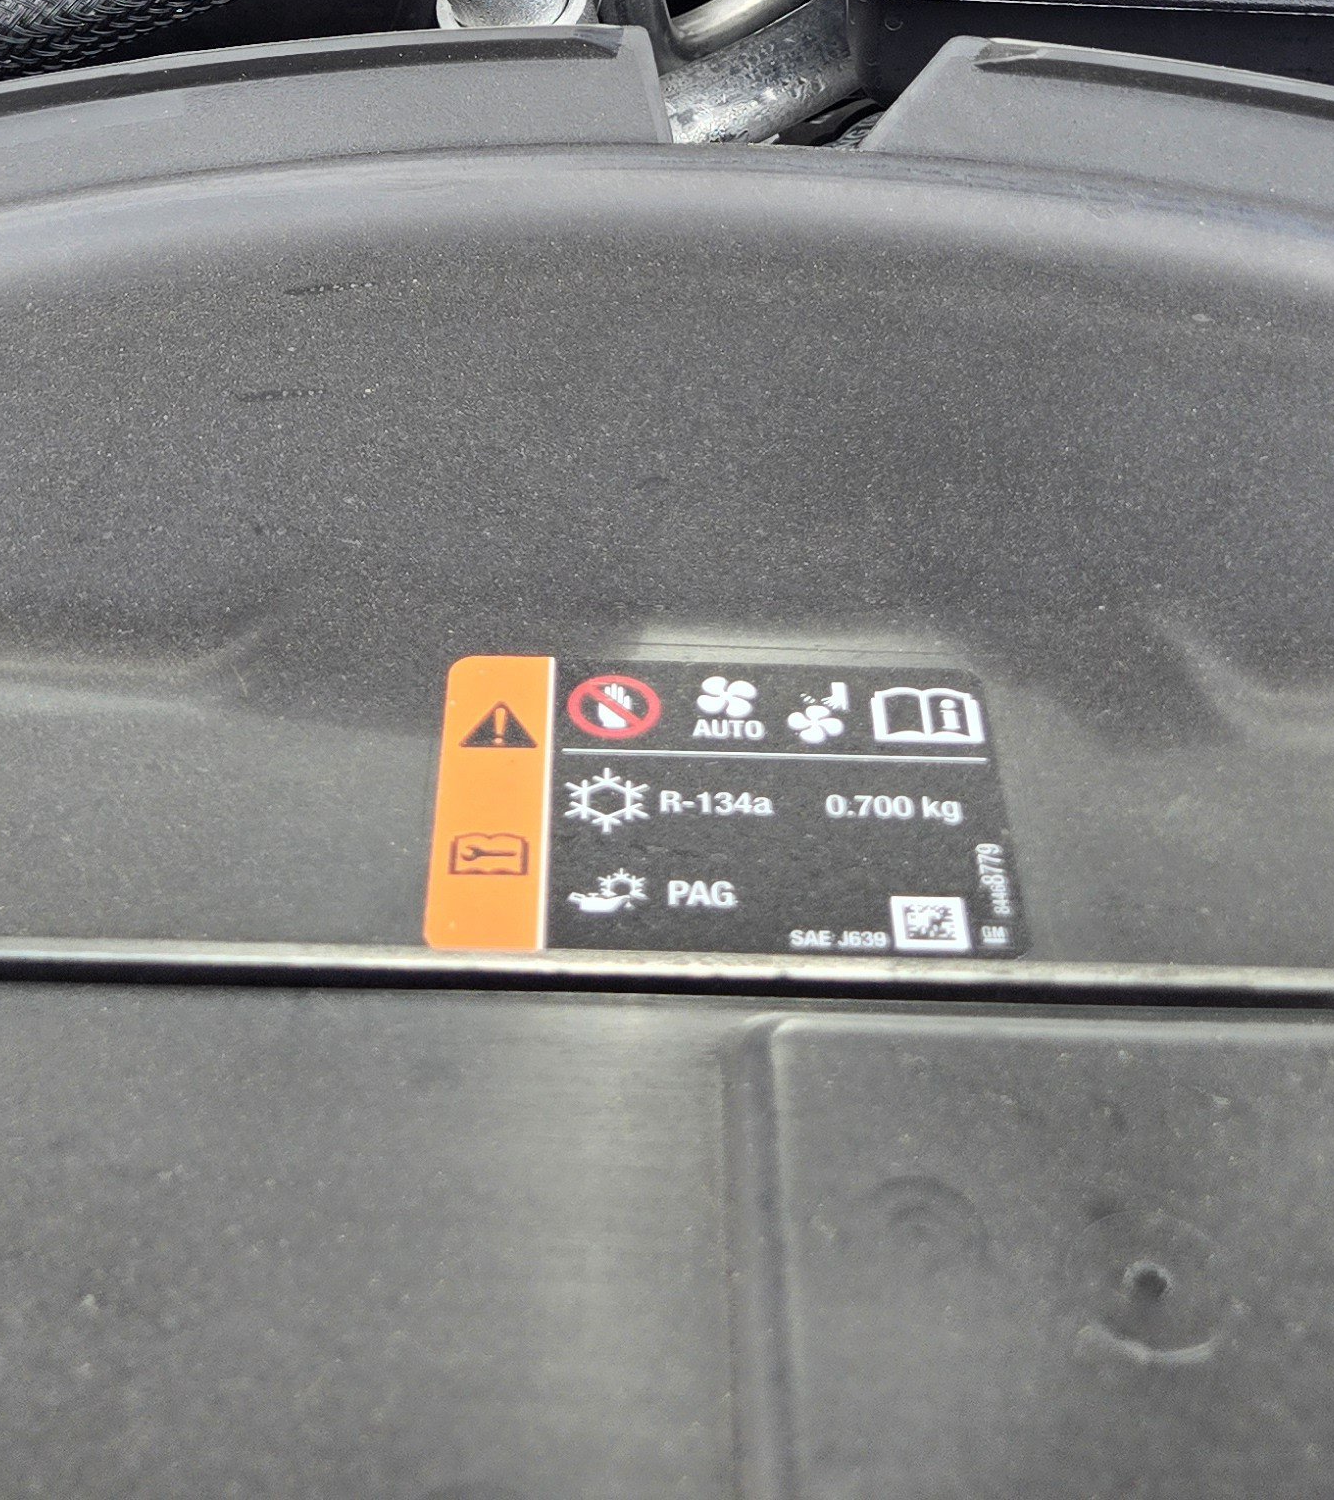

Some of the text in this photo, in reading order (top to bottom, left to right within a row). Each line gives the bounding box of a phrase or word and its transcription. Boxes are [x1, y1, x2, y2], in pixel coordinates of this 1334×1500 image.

[691, 718, 766, 740] AUTO
[659, 789, 774, 817] R-134a
[824, 794, 965, 826] 0.700 kg
[667, 879, 739, 908] PAG
[789, 929, 889, 949] SAE J639
[982, 925, 1007, 944] GM
